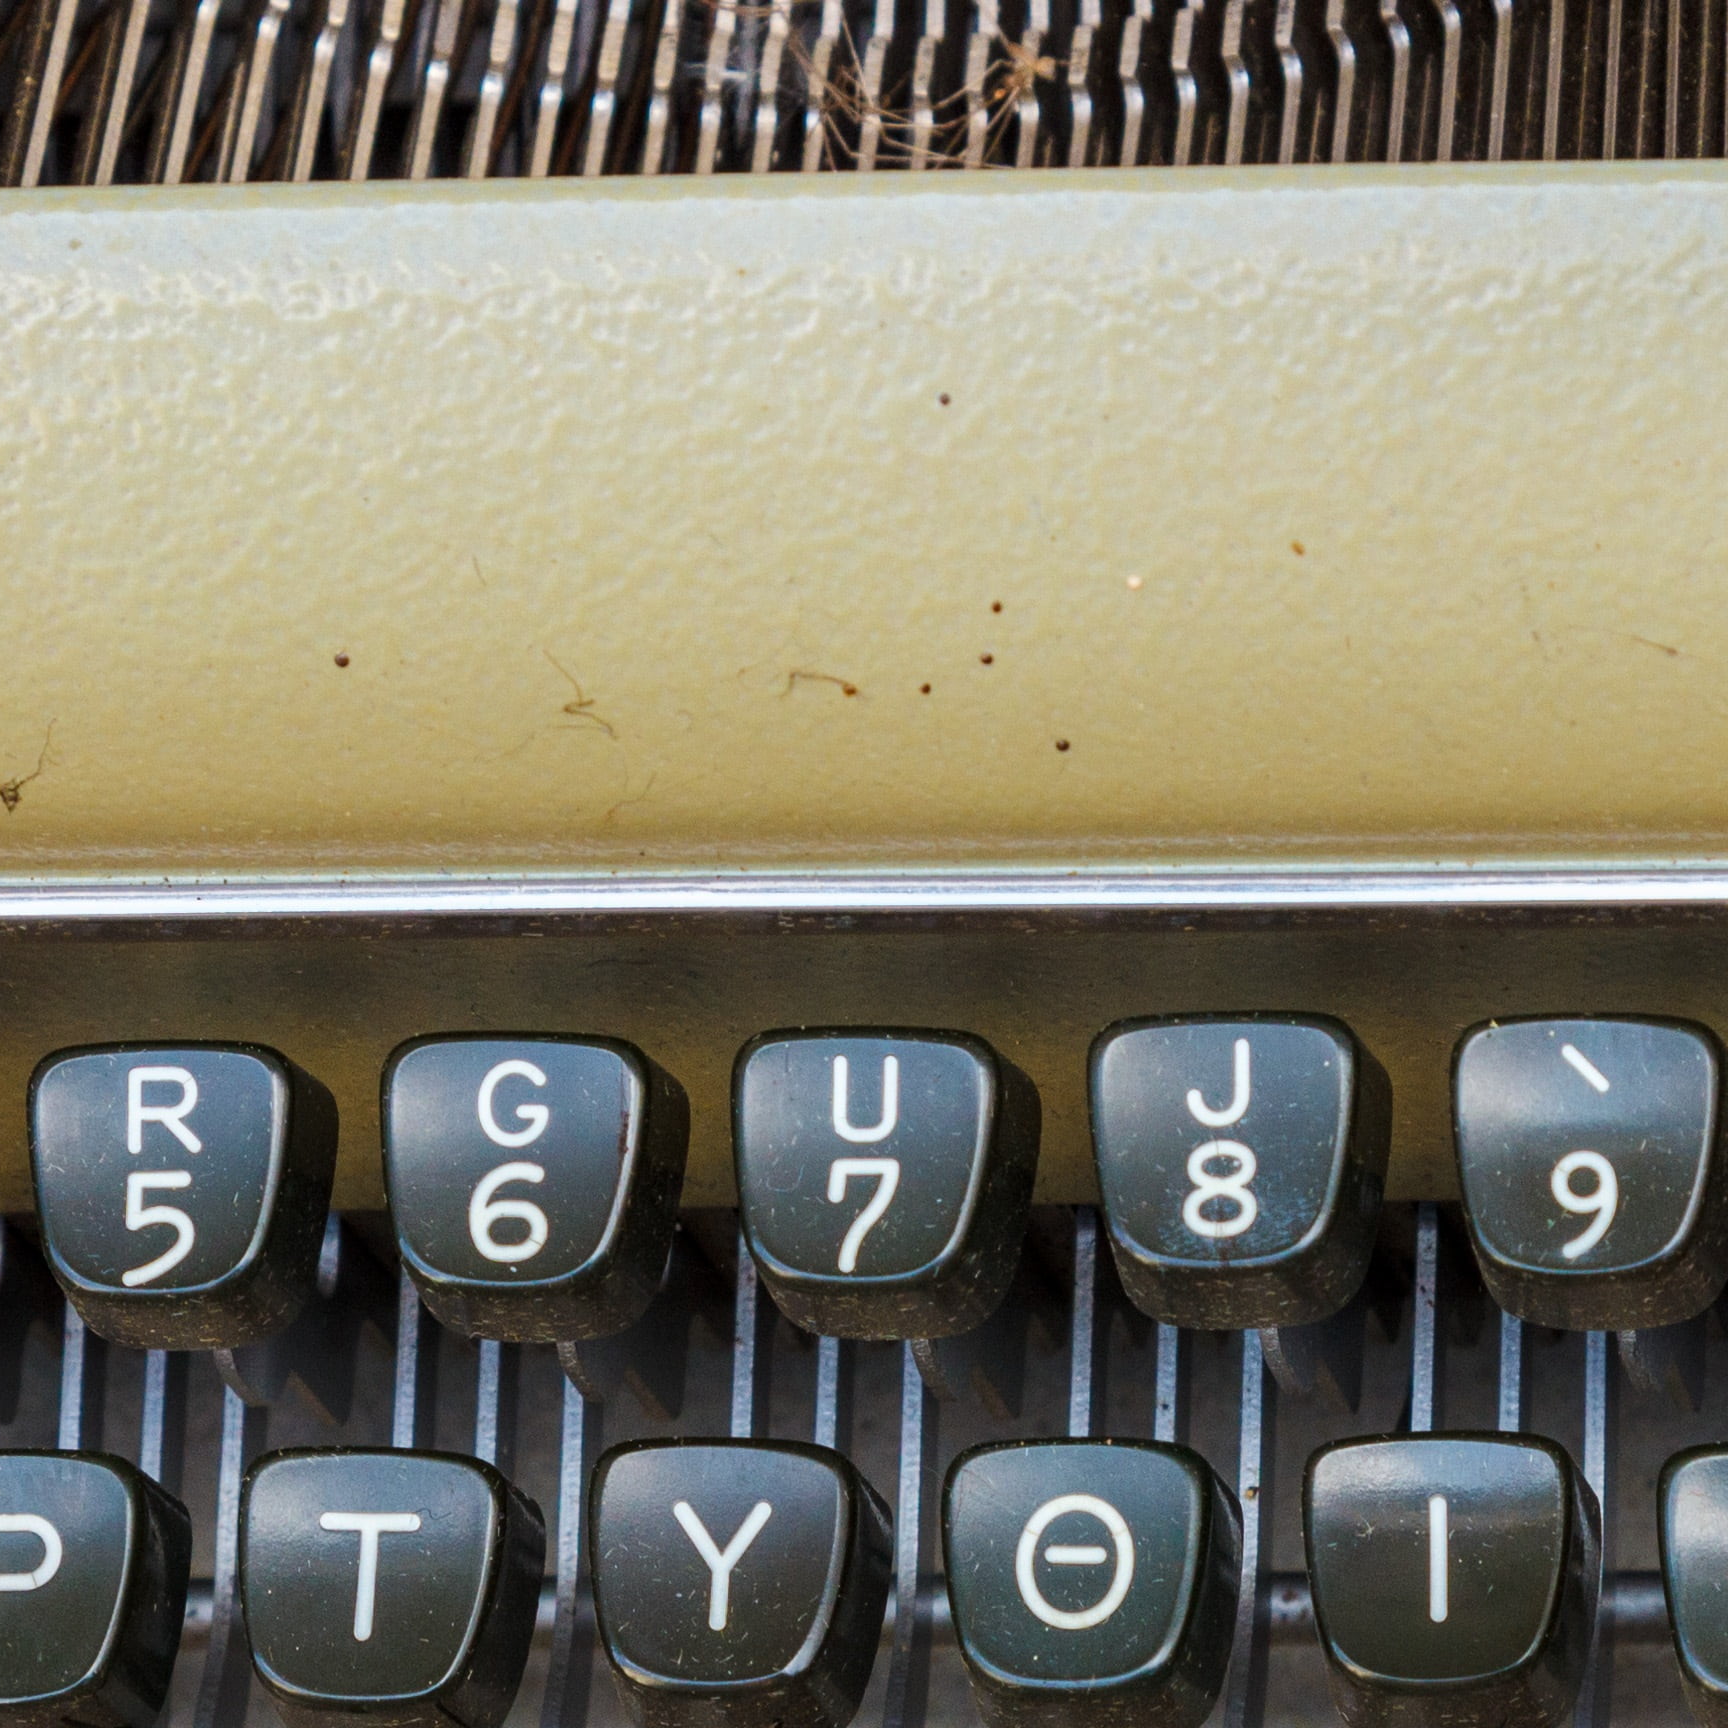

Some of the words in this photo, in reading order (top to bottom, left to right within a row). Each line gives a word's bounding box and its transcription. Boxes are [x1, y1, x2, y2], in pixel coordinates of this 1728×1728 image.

[126, 1065, 203, 1155] R
[476, 1058, 550, 1148] G
[831, 1054, 899, 1143] U
[1185, 1037, 1251, 1128] J
[121, 1170, 195, 1288] 5
[468, 1161, 548, 1261] 6
[827, 1157, 901, 1273] 7
[1183, 1139, 1258, 1238] 8
[1550, 1150, 1617, 1259] 9
[1015, 1493, 1135, 1630] Θ
